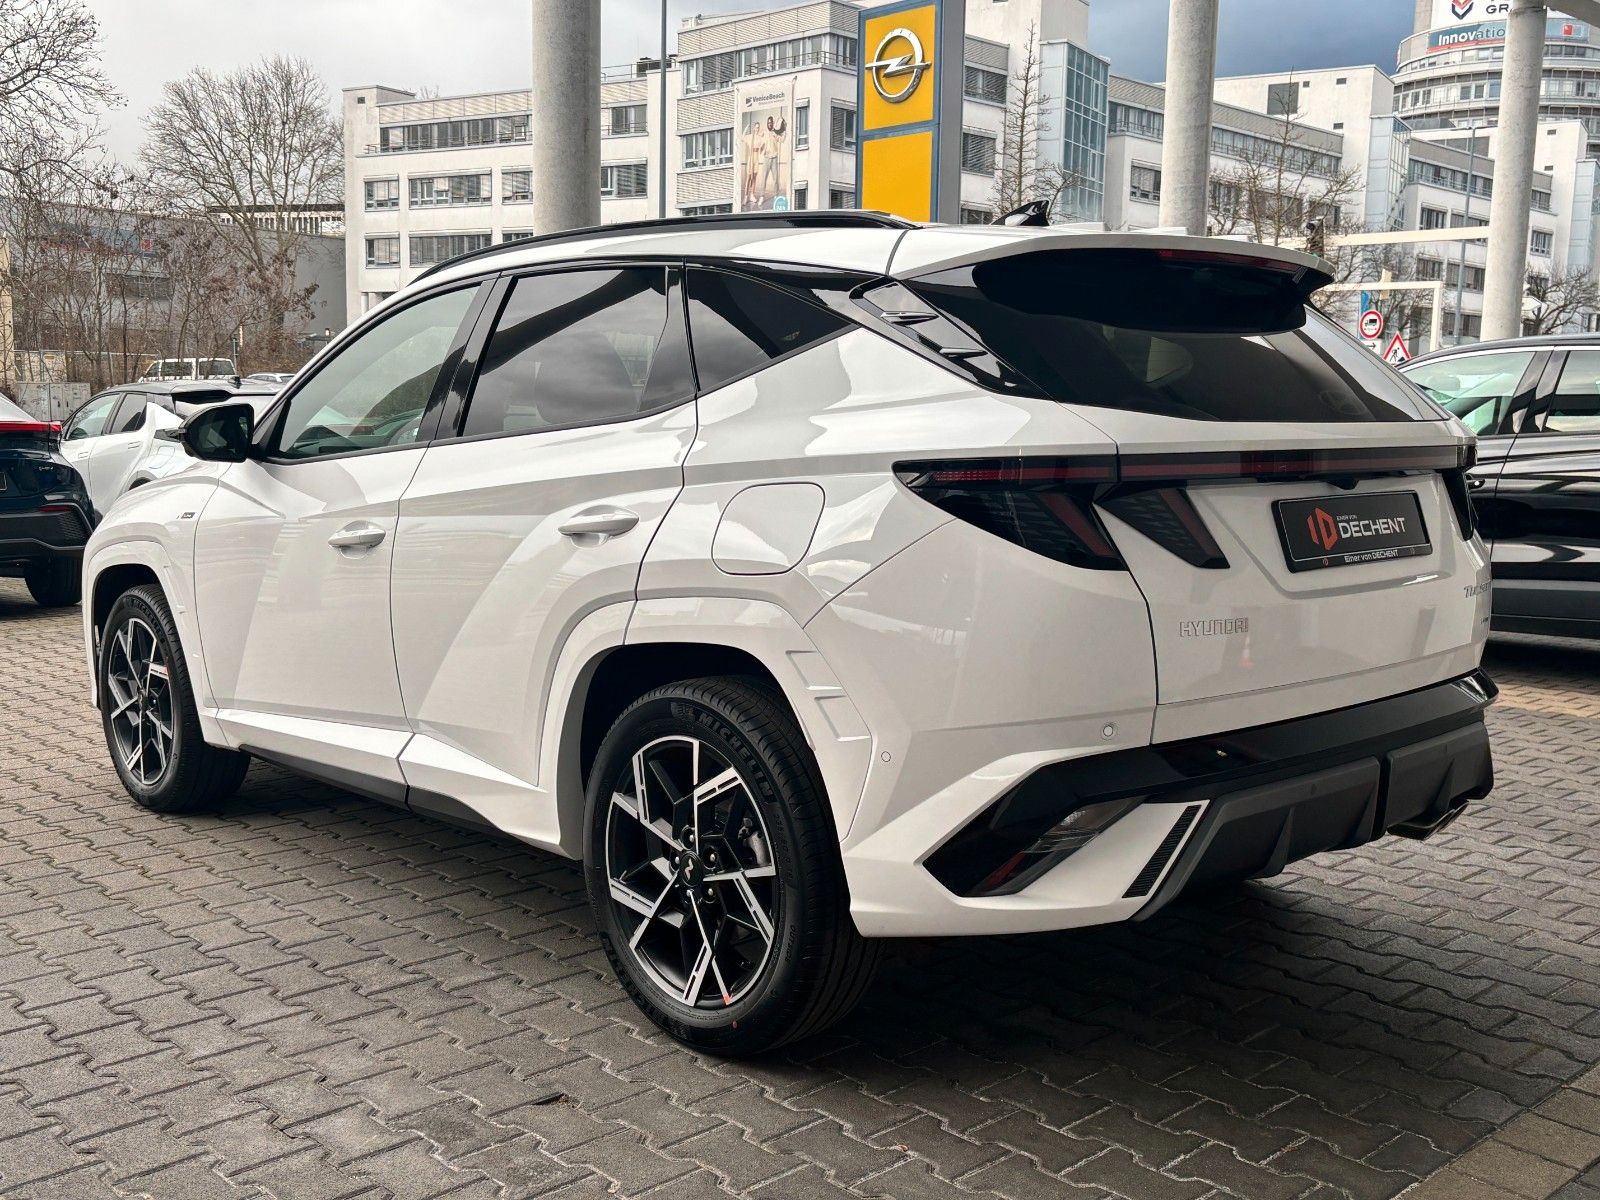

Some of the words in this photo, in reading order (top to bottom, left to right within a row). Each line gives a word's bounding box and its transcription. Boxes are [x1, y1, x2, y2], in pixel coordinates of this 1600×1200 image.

[1485, 3, 1513, 14] GR
[1438, 27, 1505, 45] Innovatio
[1339, 518, 1405, 538] DECHENT
[1344, 554, 1360, 563] Einer
[1373, 550, 1398, 559] DECHENT
[1179, 617, 1249, 637] HYUNDAI
[698, 712, 775, 800] MICHELIN
